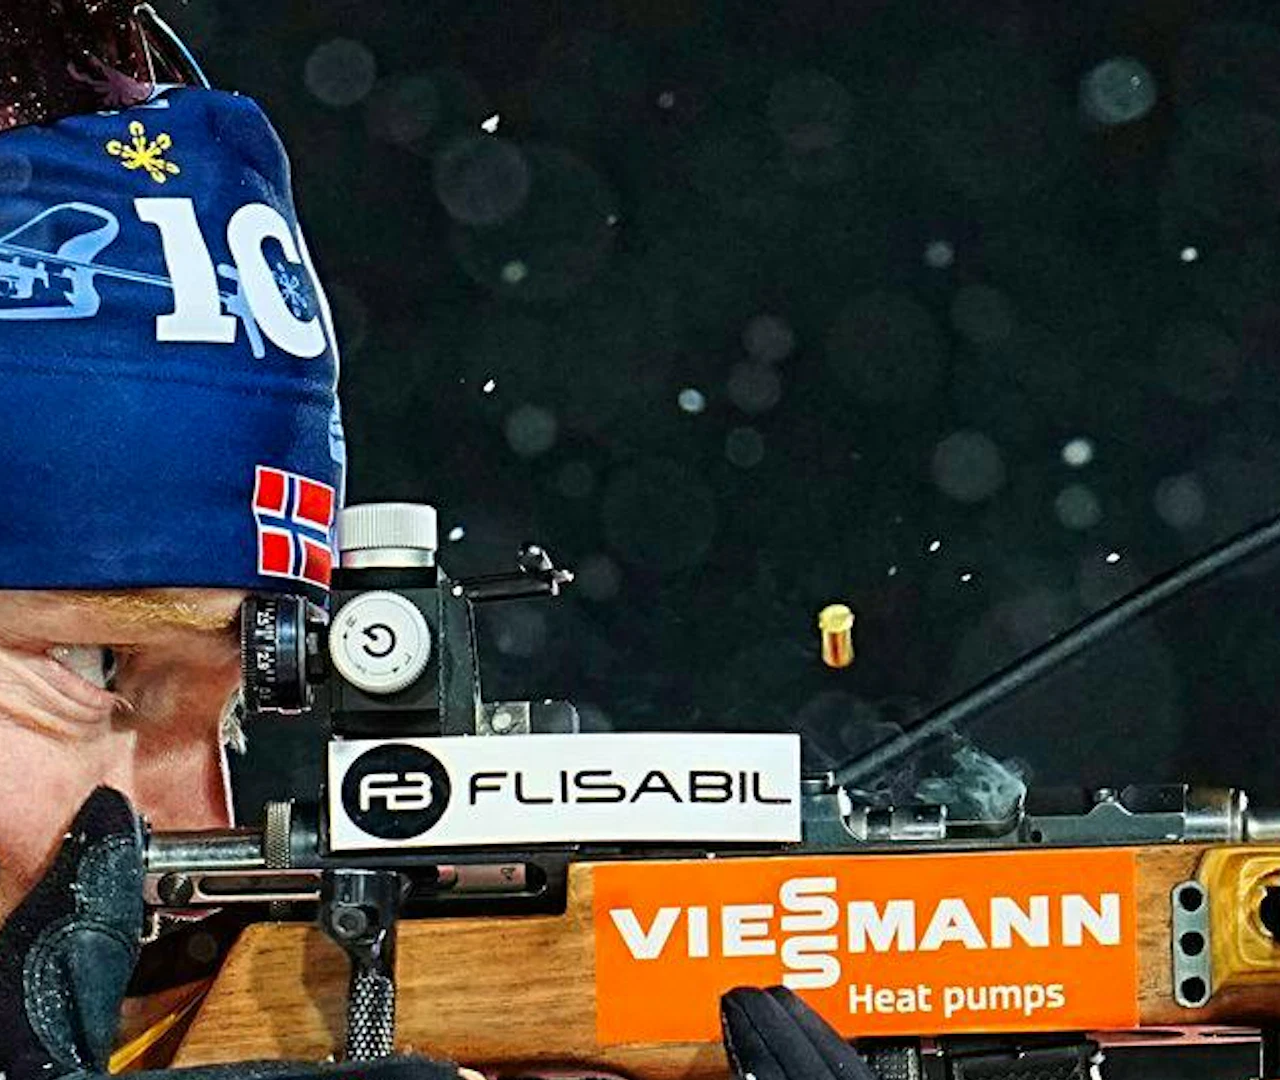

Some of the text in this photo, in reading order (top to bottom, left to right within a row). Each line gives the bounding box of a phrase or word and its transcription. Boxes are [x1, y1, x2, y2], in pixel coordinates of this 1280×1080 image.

[133, 197, 328, 358] ic
[468, 769, 793, 806] FLISABIL
[609, 876, 1122, 991] VIESSMANN
[848, 982, 1066, 1019] Heat pumps
